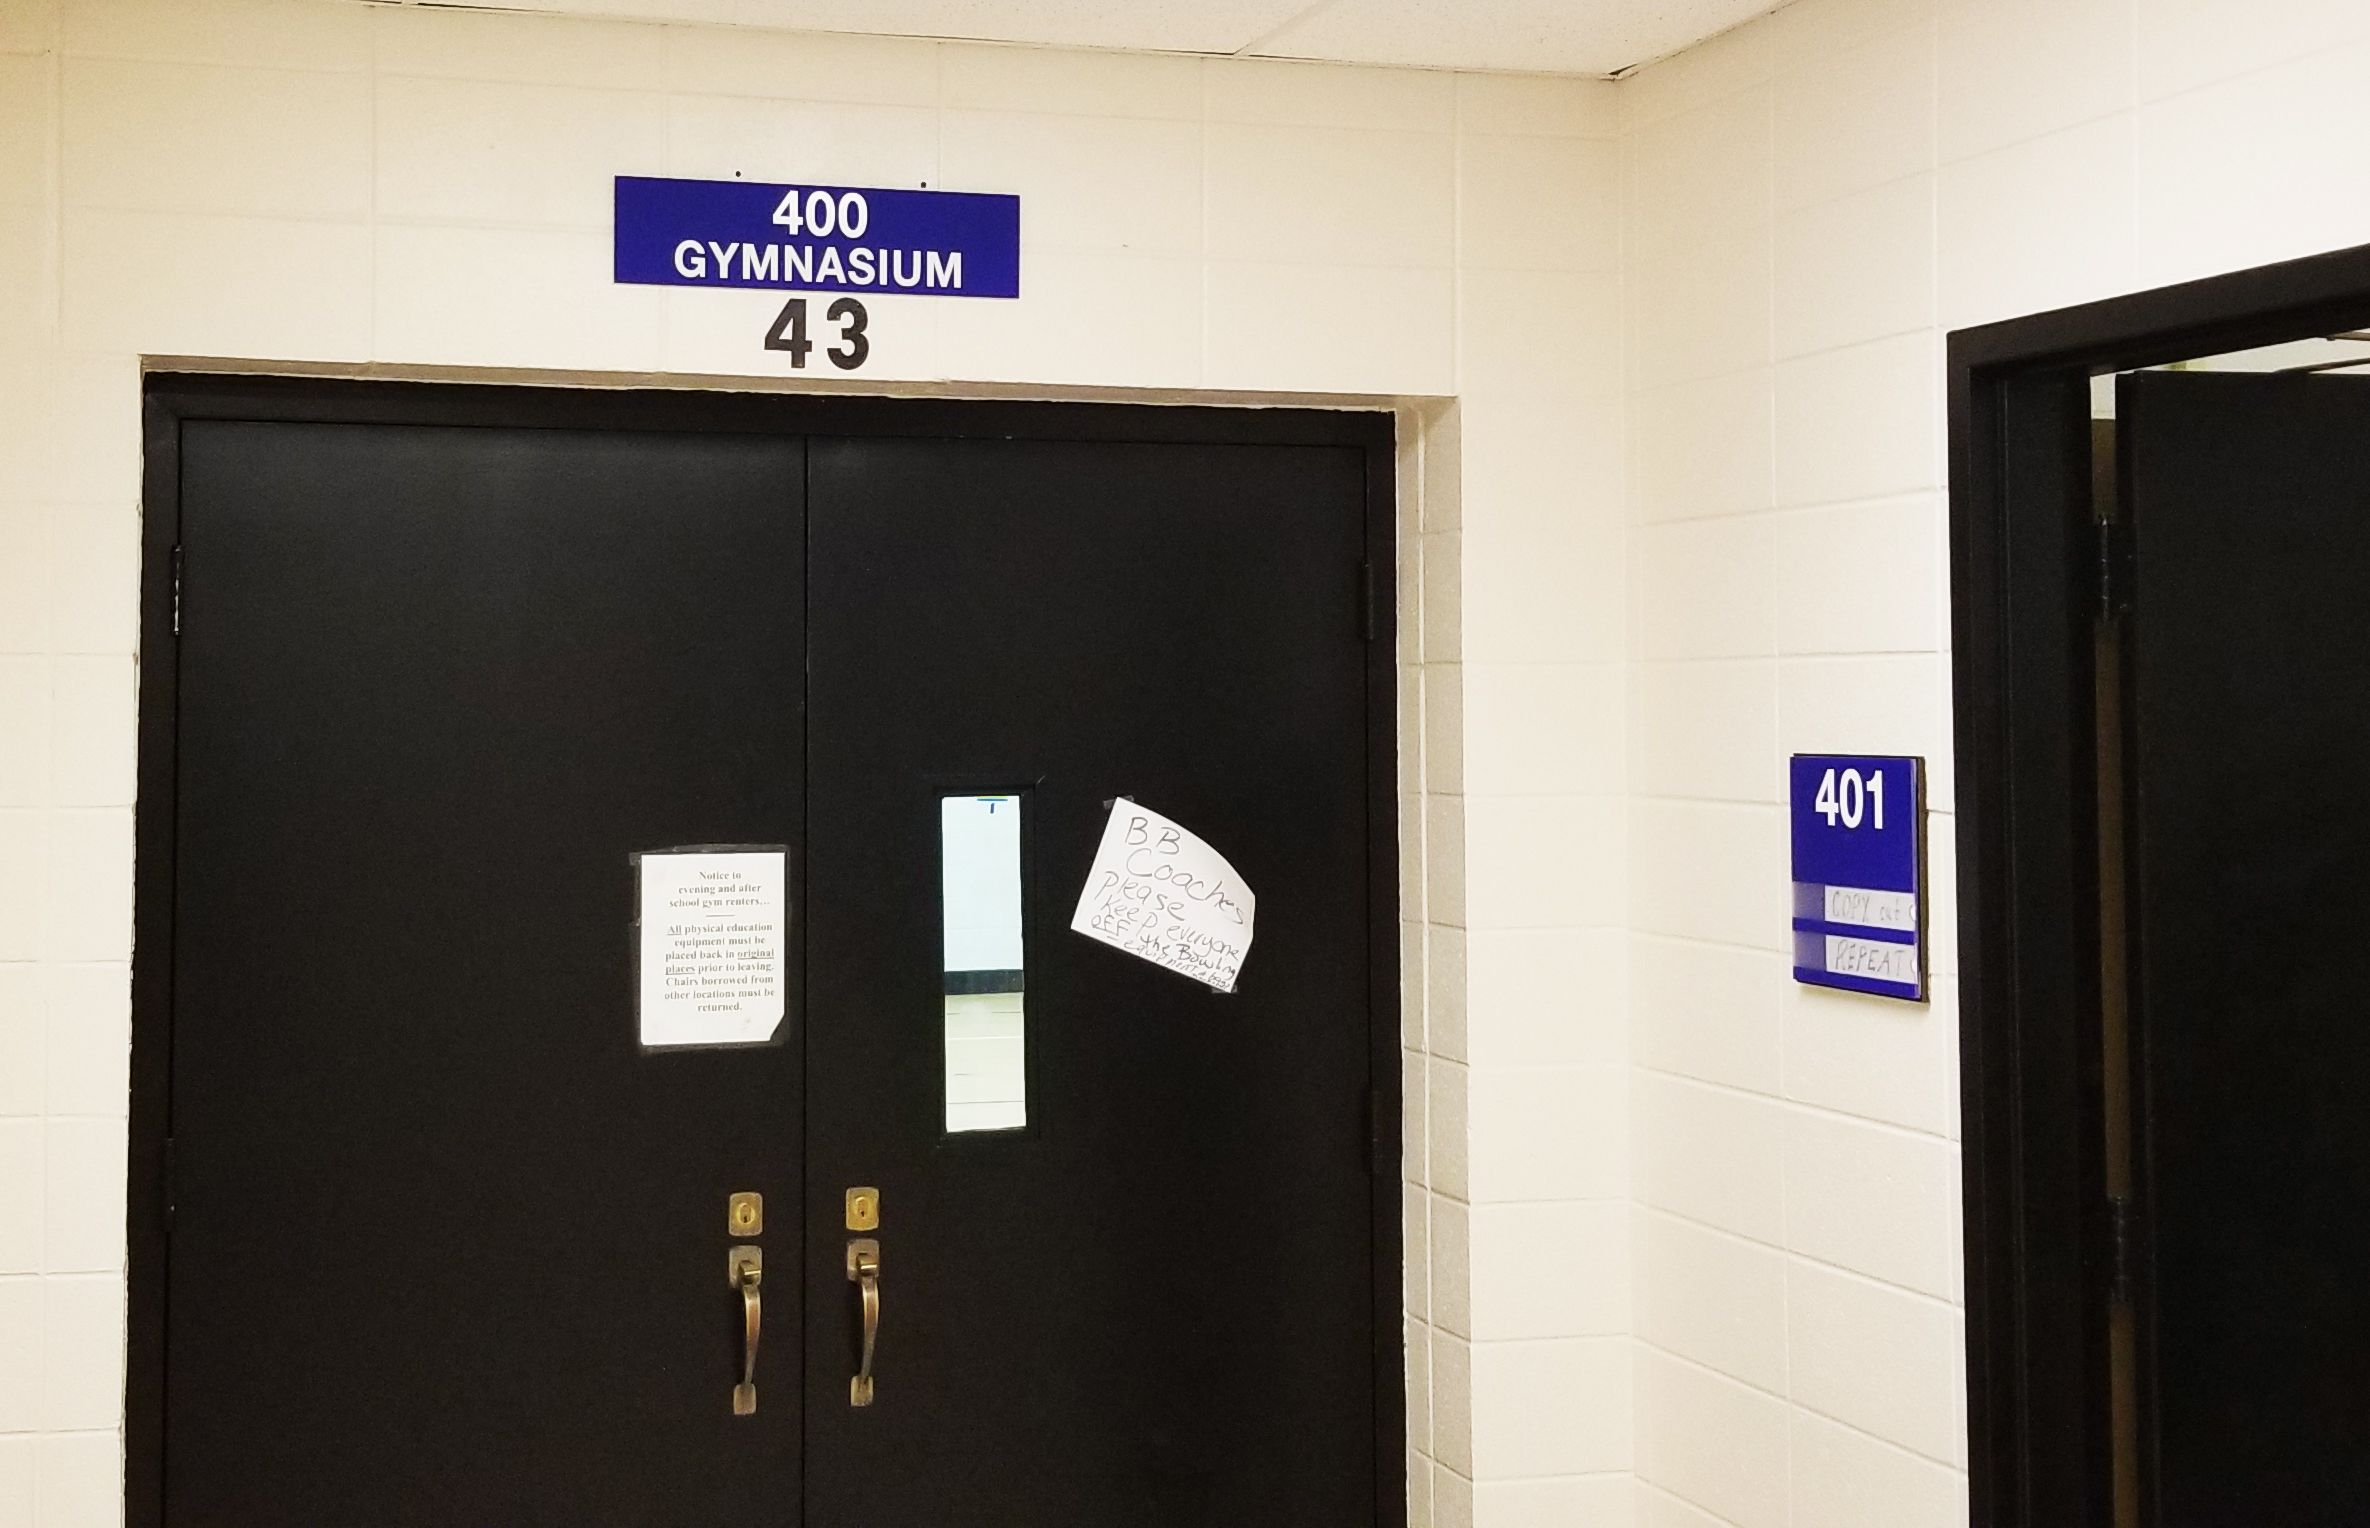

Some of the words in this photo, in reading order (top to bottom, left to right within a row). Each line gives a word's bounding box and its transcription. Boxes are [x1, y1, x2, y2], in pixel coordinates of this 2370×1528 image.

[772, 189, 868, 239] 400
[673, 239, 963, 289] GYMNASIUM
[764, 297, 870, 371] 43
[1815, 768, 1884, 829] 401
[699, 870, 730, 880] Notice
[732, 871, 742, 880] to
[678, 884, 716, 895] evening
[718, 884, 736, 893] and
[738, 883, 762, 892] after
[1126, 847, 1245, 925] Coaches
[669, 898, 700, 908] school
[702, 899, 723, 909] gym
[1832, 890, 1871, 924] COPY
[667, 924, 682, 936] All
[684, 923, 724, 936] physical
[726, 922, 773, 932] education
[674, 937, 725, 949] equipment
[728, 937, 752, 946] must
[754, 936, 766, 944] be
[1166, 925, 1240, 961] everyone
[665, 950, 697, 963] placed
[699, 950, 723, 960] back
[725, 949, 735, 959] in
[737, 948, 775, 960] original
[1835, 939, 1906, 977] REPEAT
[664, 963, 696, 976] places
[698, 962, 723, 975] prior
[725, 962, 735, 972] to
[737, 961, 775, 973] leaving.
[666, 976, 698, 987] Chairs
[700, 975, 748, 986] borrowed
[750, 974, 774, 985] from
[664, 990, 691, 1000] other
[693, 989, 736, 1000] locations
[738, 988, 762, 998] must
[764, 987, 775, 997] be
[697, 1002, 743, 1013] returned.
